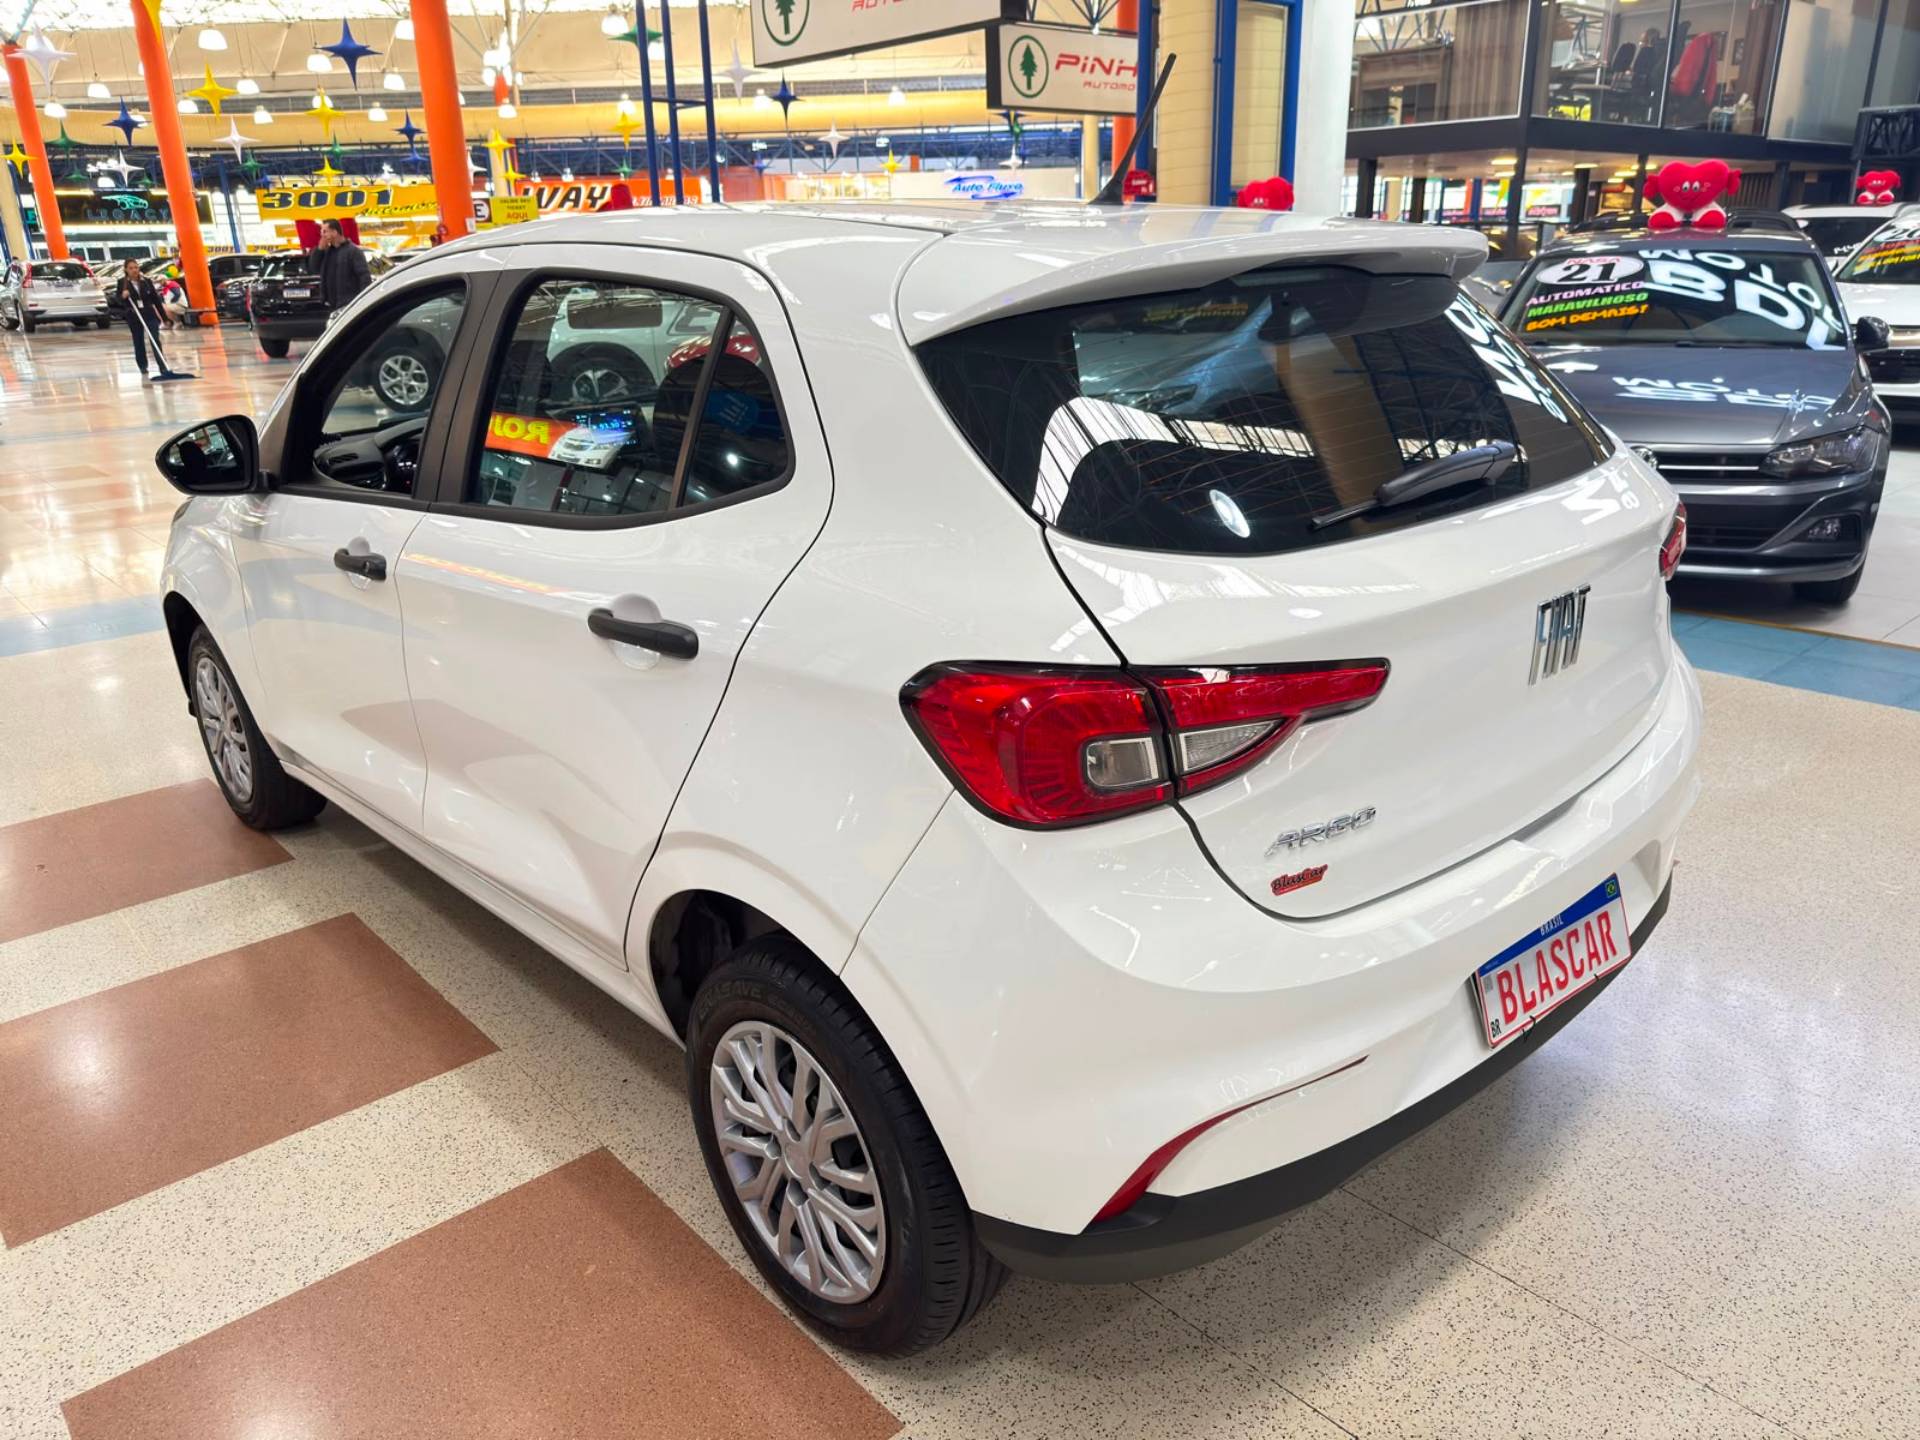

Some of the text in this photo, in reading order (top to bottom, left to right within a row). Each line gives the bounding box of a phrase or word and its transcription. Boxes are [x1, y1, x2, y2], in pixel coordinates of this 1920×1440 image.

[262, 189, 394, 209] 3001
[473, 203, 486, 219] E
[506, 210, 529, 219] AQUI
[1556, 261, 1617, 283] 21
[1526, 281, 1645, 306] AUTOMATICO
[1527, 292, 1649, 318] MARAVILHOSO
[1525, 315, 1567, 332] BOM
[1528, 583, 1591, 687] FIAT
[1264, 806, 1377, 857] ARGO
[1540, 914, 1564, 937] BRASIL
[1496, 910, 1617, 1025] BLASCAR
[1490, 1018, 1502, 1038] BR
